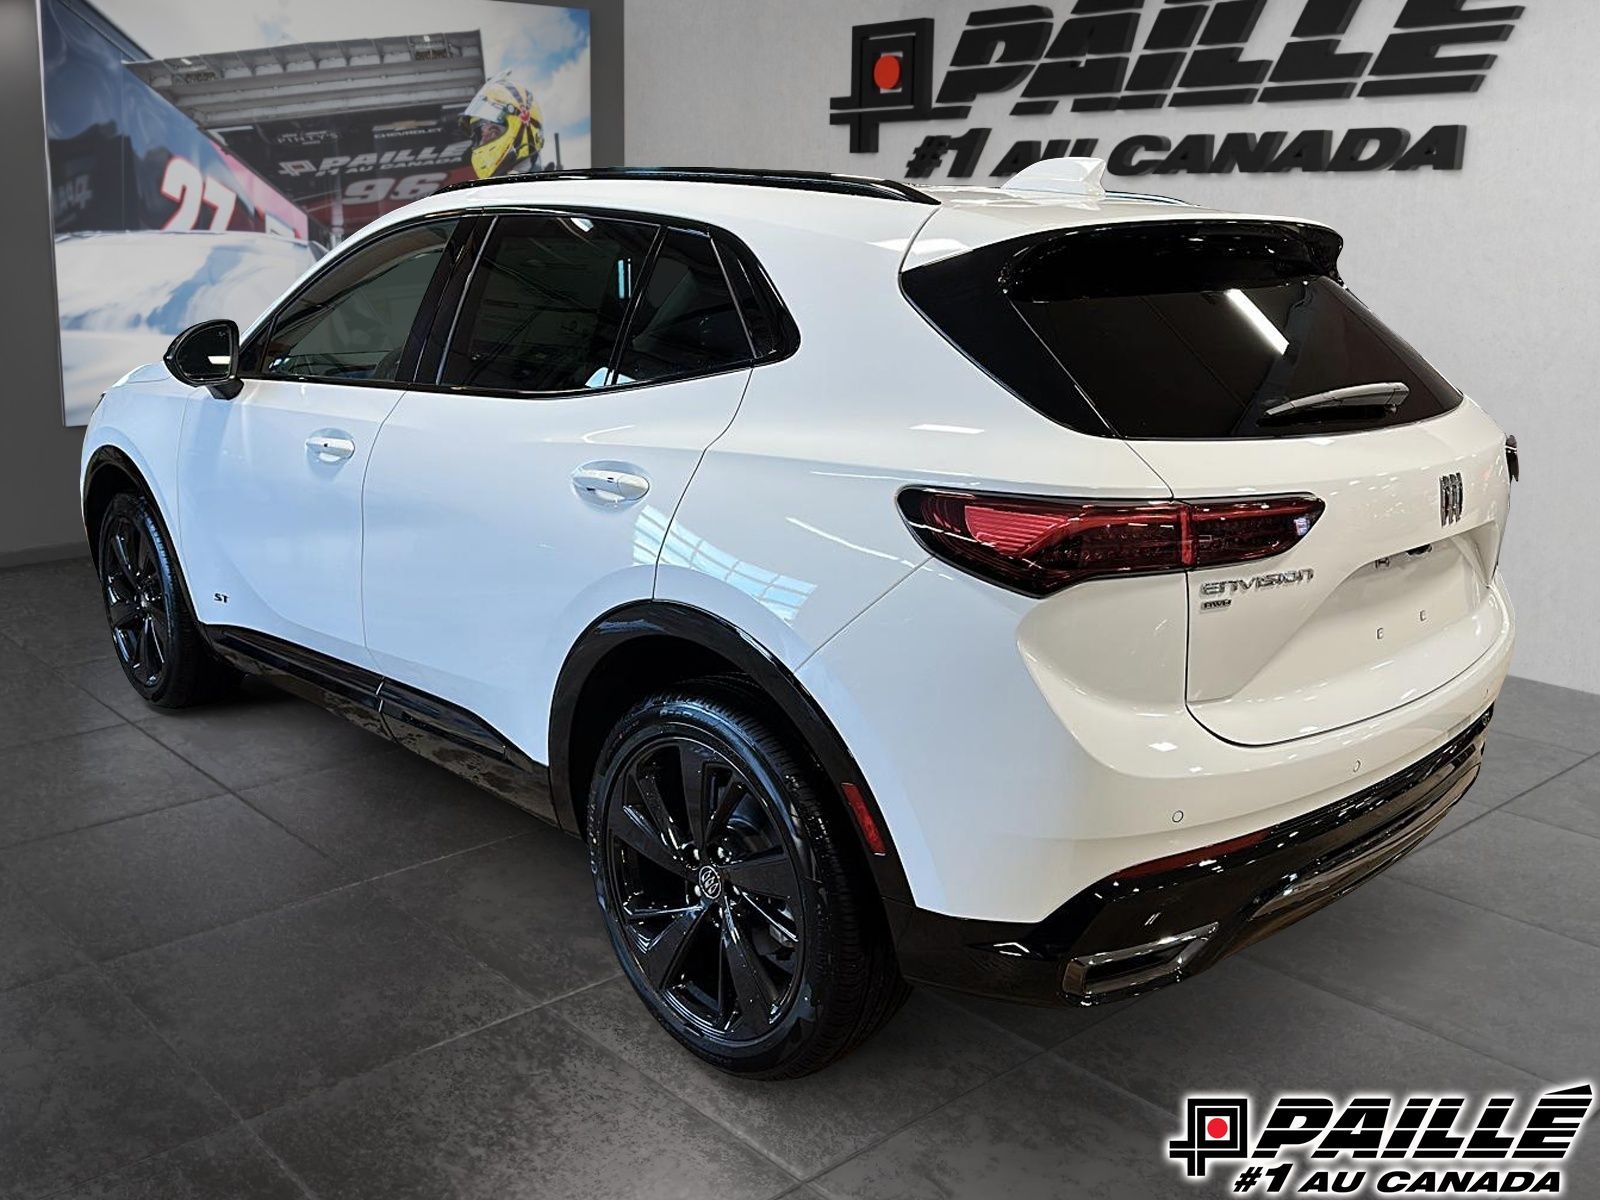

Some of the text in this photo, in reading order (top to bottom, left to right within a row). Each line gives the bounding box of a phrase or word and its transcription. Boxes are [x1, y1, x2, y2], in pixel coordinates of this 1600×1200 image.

[904, 128, 992, 178] #1
[1106, 125, 1467, 176] CANADA
[160, 156, 236, 231] 27
[342, 172, 448, 205] 96
[213, 592, 230, 604] ST
[1200, 568, 1315, 596] ENVISION
